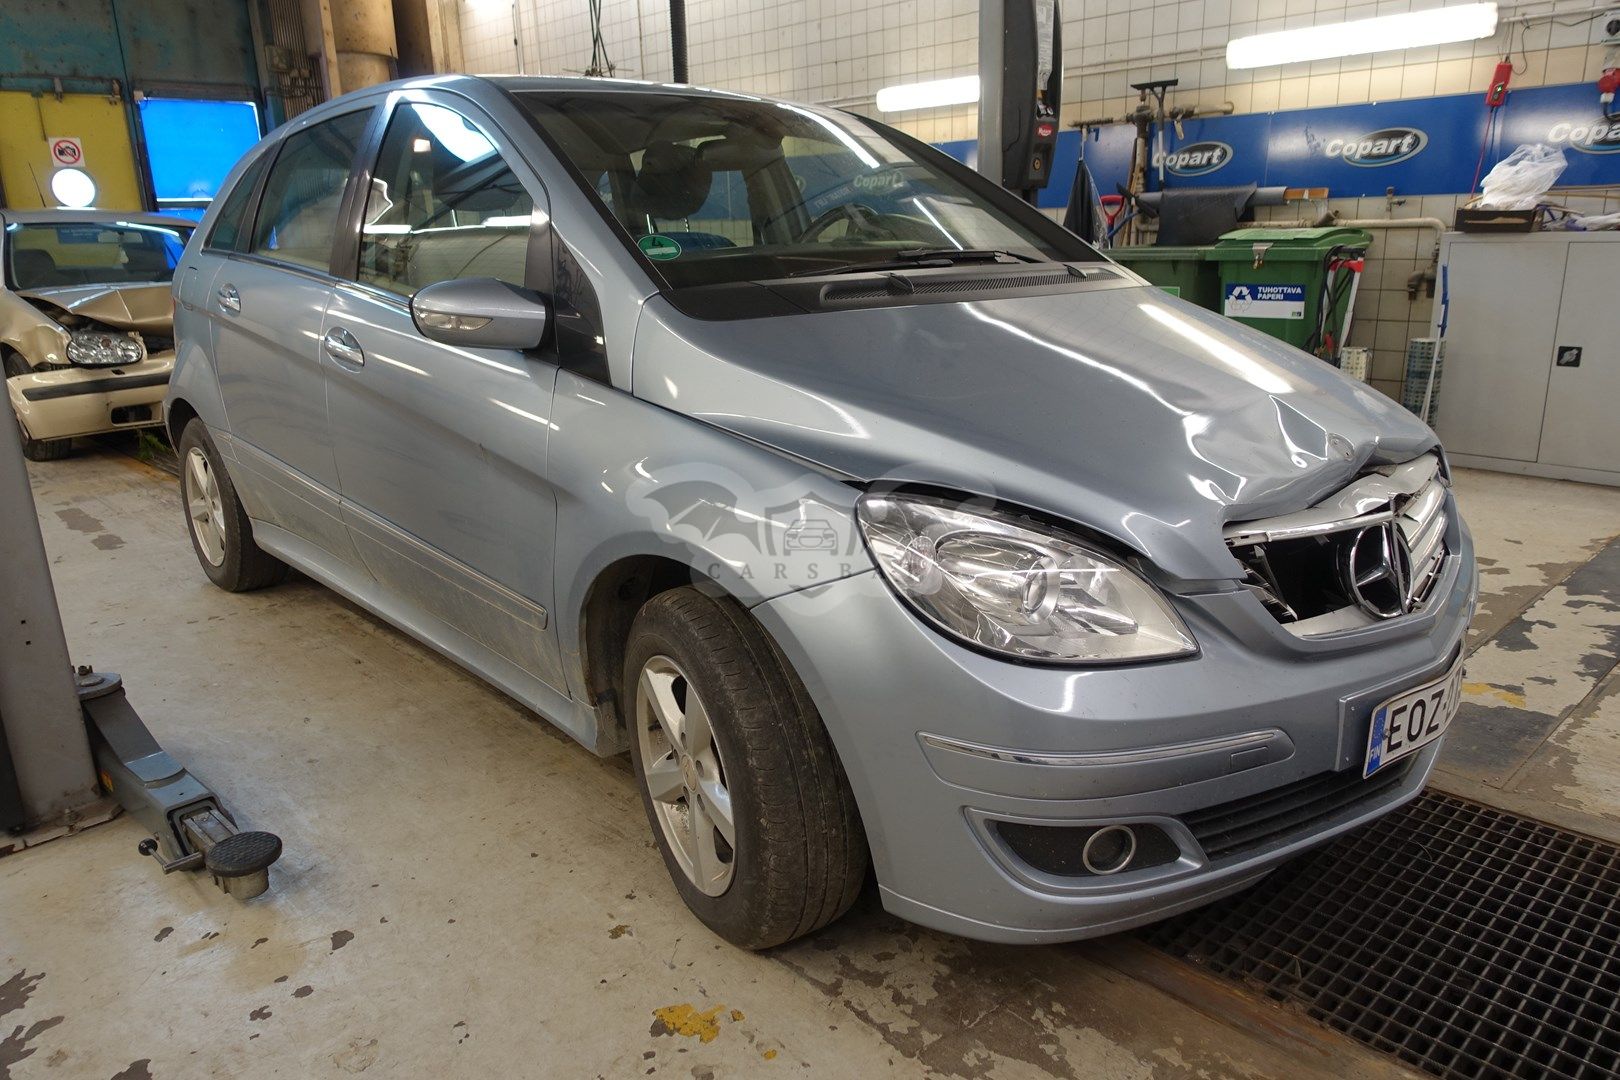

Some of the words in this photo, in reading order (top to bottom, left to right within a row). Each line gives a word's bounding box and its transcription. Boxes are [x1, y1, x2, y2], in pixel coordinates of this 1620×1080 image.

[1324, 131, 1414, 159] Copart
[1152, 147, 1222, 169] Copart
[652, 237, 664, 247] 4
[1257, 286, 1302, 294] TUHOTTAVA
[1369, 743, 1382, 761] FIN
